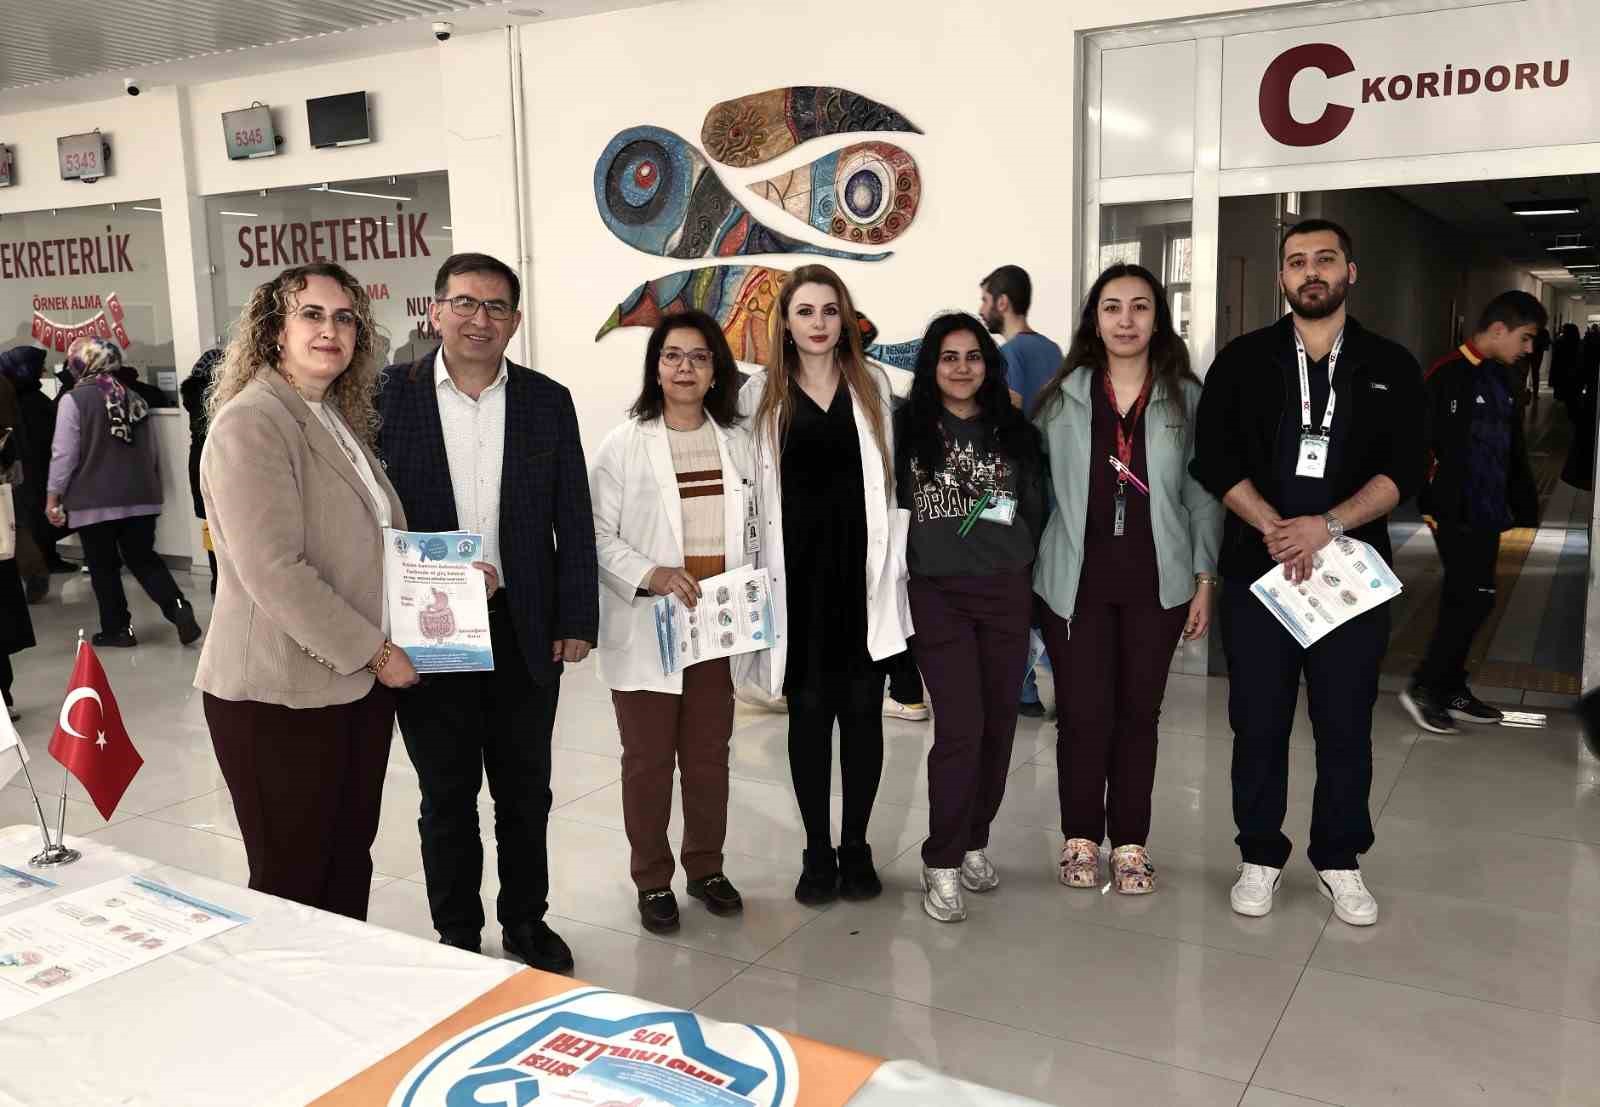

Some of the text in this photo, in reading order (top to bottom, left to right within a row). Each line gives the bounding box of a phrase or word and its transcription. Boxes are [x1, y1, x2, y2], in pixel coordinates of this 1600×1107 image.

[1258, 42, 1570, 148] C KORİDORU
[235, 127, 264, 147] 5345
[238, 203, 432, 268] SEKRETERLİK
[367, 284, 390, 300] MA
[32, 294, 103, 311] ÖRNEK ALMA
[629, 1028, 675, 1048] 1975
